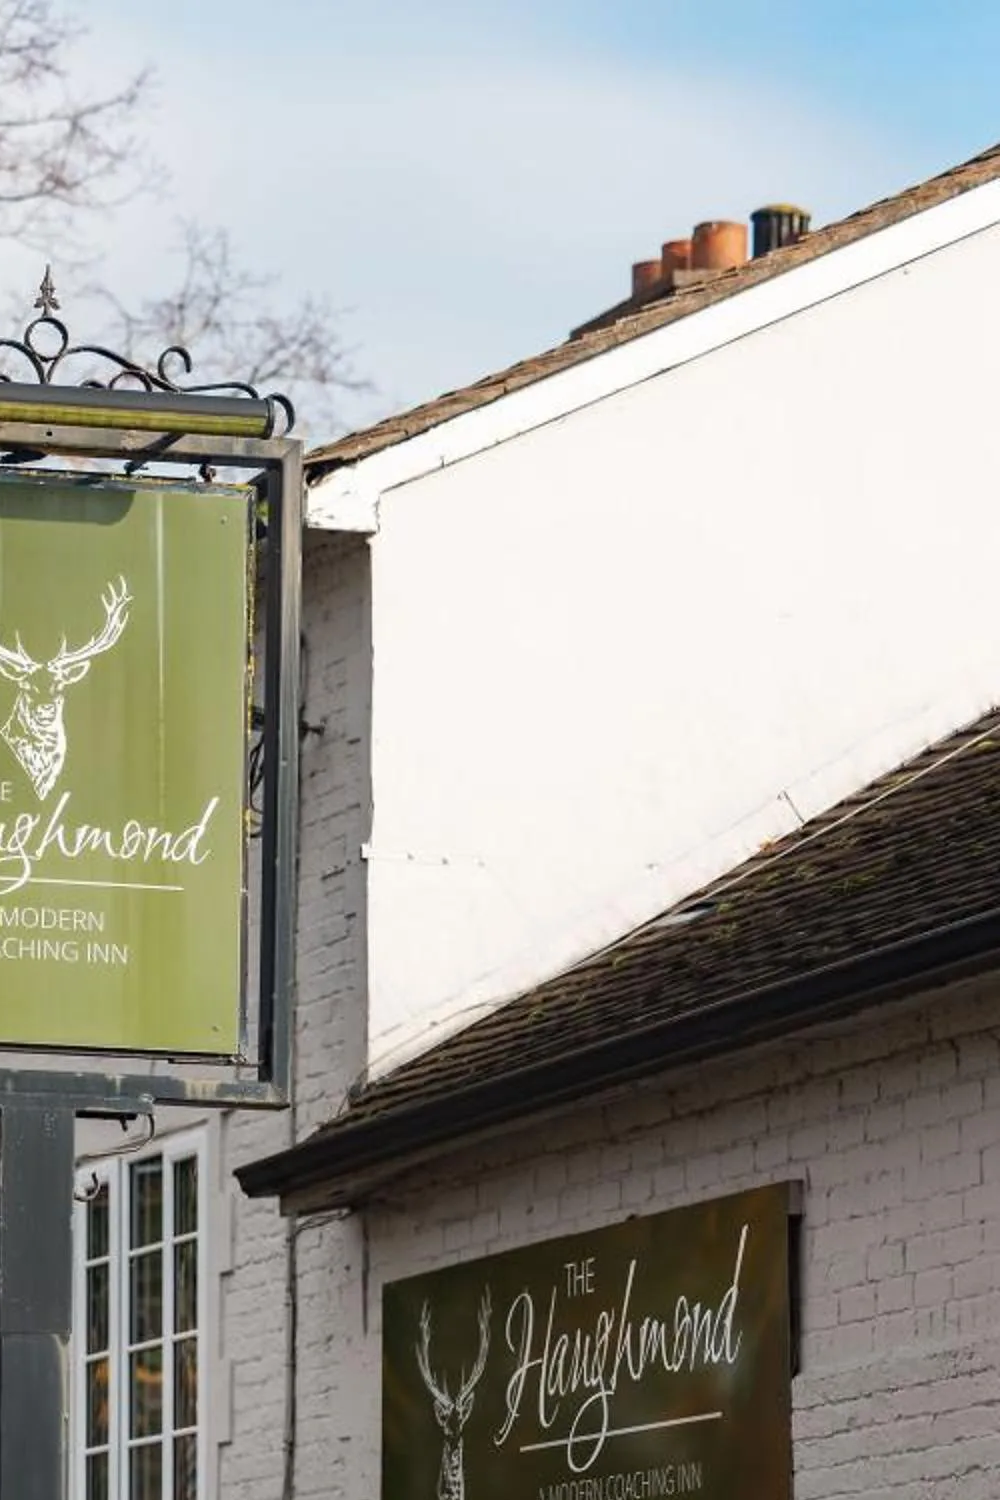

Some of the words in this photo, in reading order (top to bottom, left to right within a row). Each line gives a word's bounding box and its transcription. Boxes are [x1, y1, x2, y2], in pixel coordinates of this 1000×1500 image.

[0, 906, 105, 932] MODERN
[87, 942, 129, 965] INN
[564, 1257, 596, 1297] THE
[494, 1223, 749, 1473] Haughmond
[677, 1461, 703, 1494] INN
